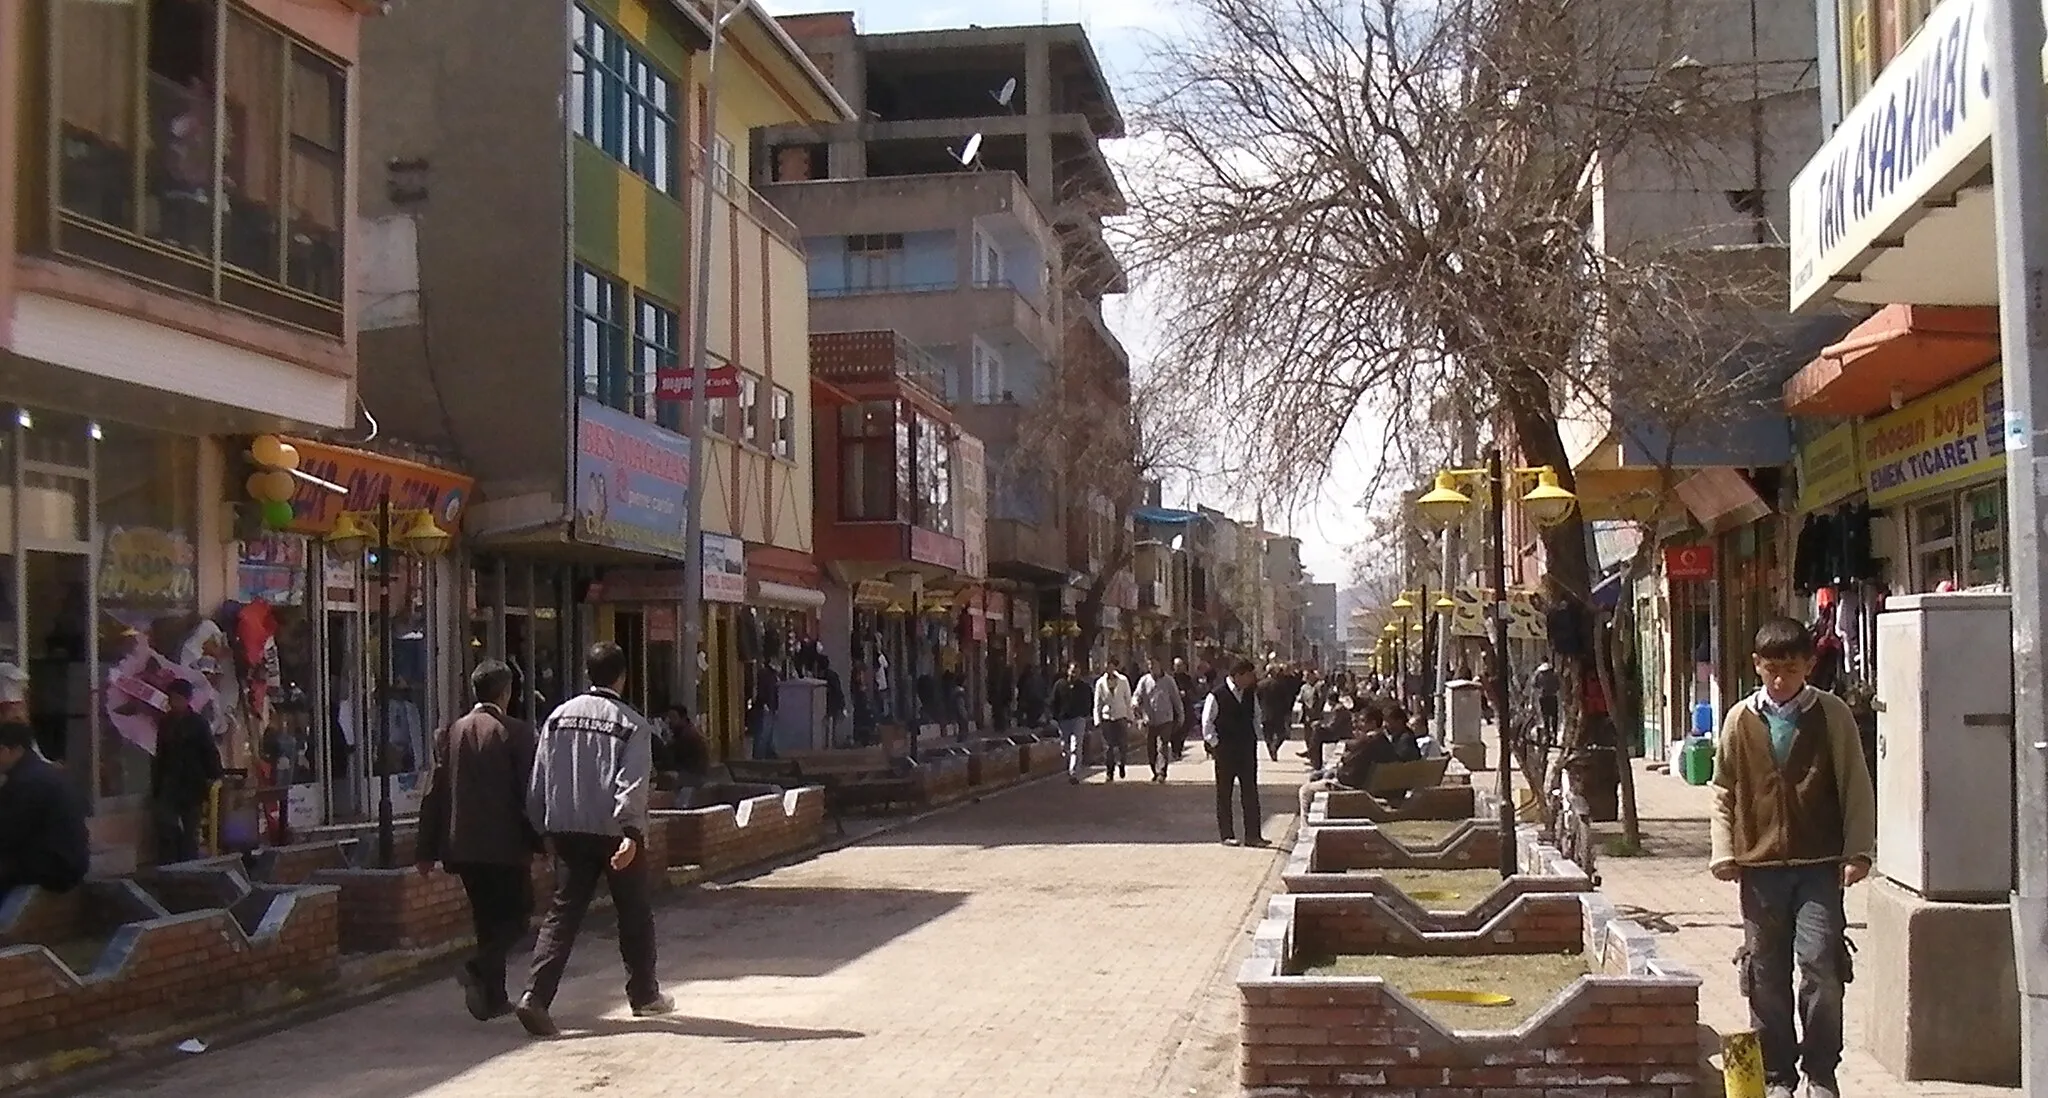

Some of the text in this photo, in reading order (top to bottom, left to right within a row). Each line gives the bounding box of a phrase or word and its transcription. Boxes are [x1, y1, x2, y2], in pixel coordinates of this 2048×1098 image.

[1818, 2, 1974, 258] TAN AYAKKABI
[1933, 397, 1979, 438] boya
[1870, 460, 1907, 492] EMEK
